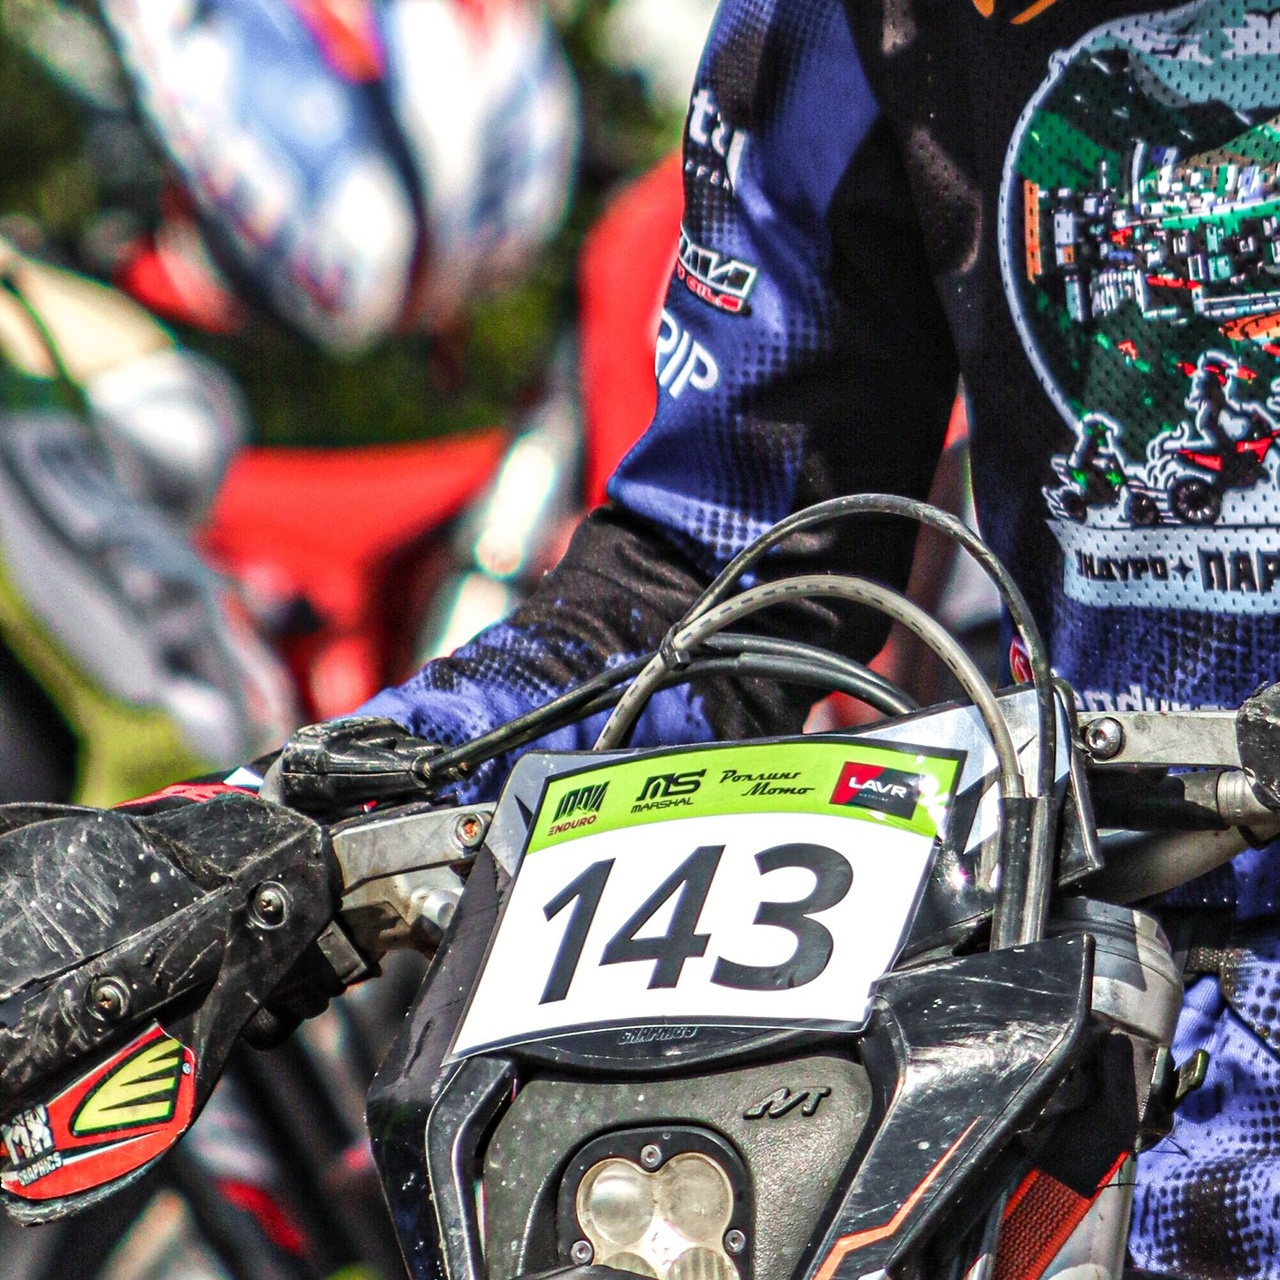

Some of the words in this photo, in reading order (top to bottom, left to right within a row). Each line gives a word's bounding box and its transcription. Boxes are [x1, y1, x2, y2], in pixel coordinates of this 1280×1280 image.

[740, 781, 816, 797] Мото
[848, 776, 908, 799] LAVR
[630, 797, 695, 815] MARSHAL
[547, 814, 598, 837] ENDURO
[538, 842, 854, 1006] 143
